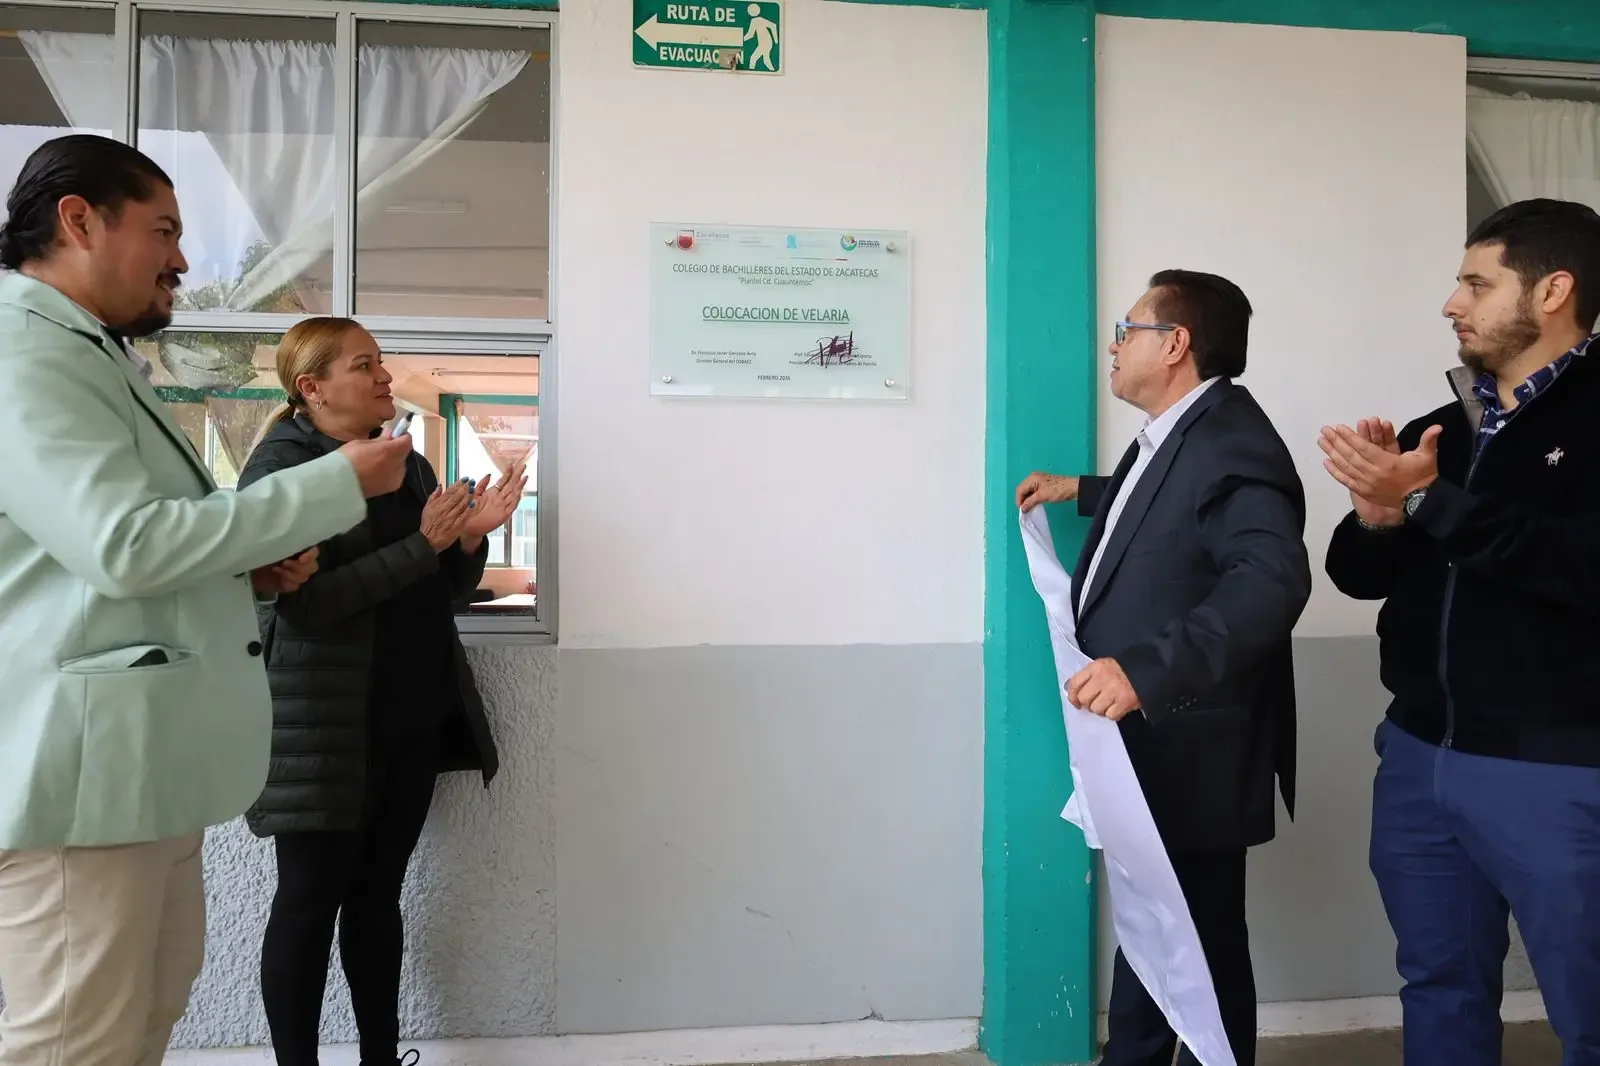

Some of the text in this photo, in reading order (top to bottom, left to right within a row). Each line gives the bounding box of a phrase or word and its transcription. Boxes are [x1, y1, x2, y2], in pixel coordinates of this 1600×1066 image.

[667, 4, 736, 23] RUTA DE
[659, 46, 744, 65] EVACUACN
[672, 263, 879, 278] COLEGIO DE BACHILLERES DEL ESTADO DE ZACATECAS
[762, 277, 773, 285] Cd.
[702, 305, 850, 322] COLOCACION DE VELARIA
